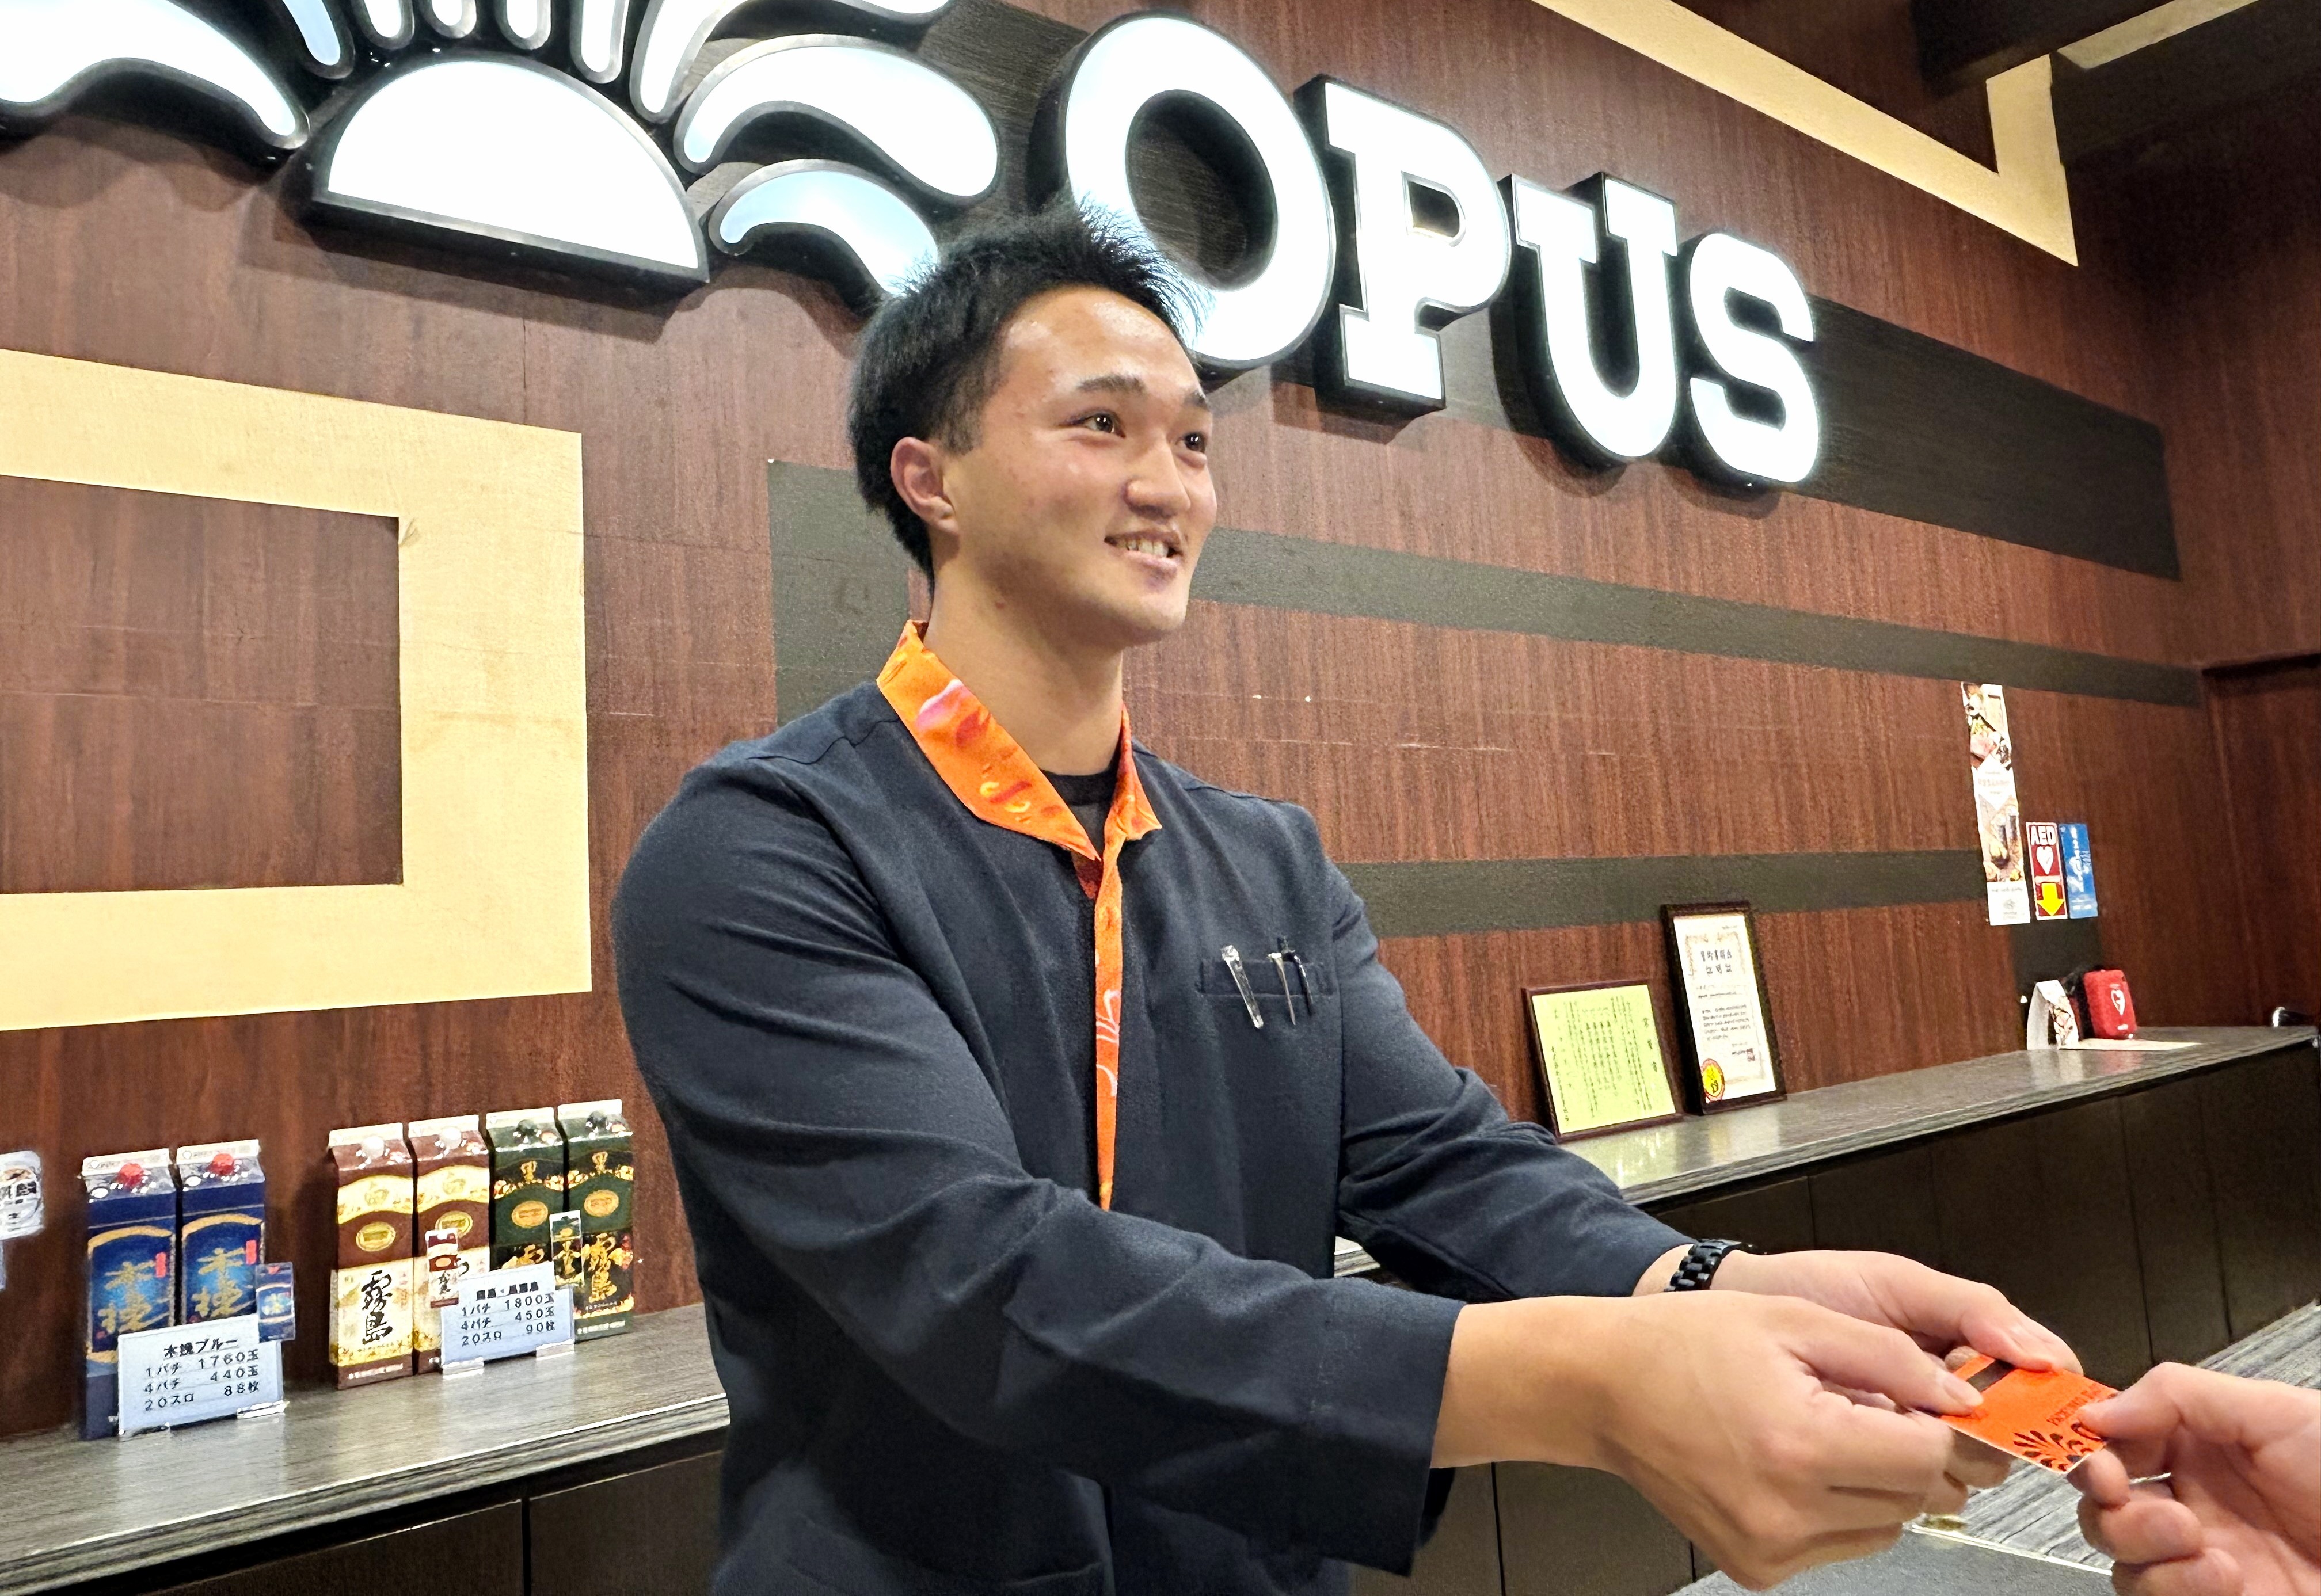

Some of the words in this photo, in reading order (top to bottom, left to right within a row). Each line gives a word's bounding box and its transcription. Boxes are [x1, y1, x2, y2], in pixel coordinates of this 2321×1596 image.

[1063, 15, 1820, 483] OPUS
[2030, 825, 2057, 845] AED
[360, 1270, 393, 1345] 霧島
